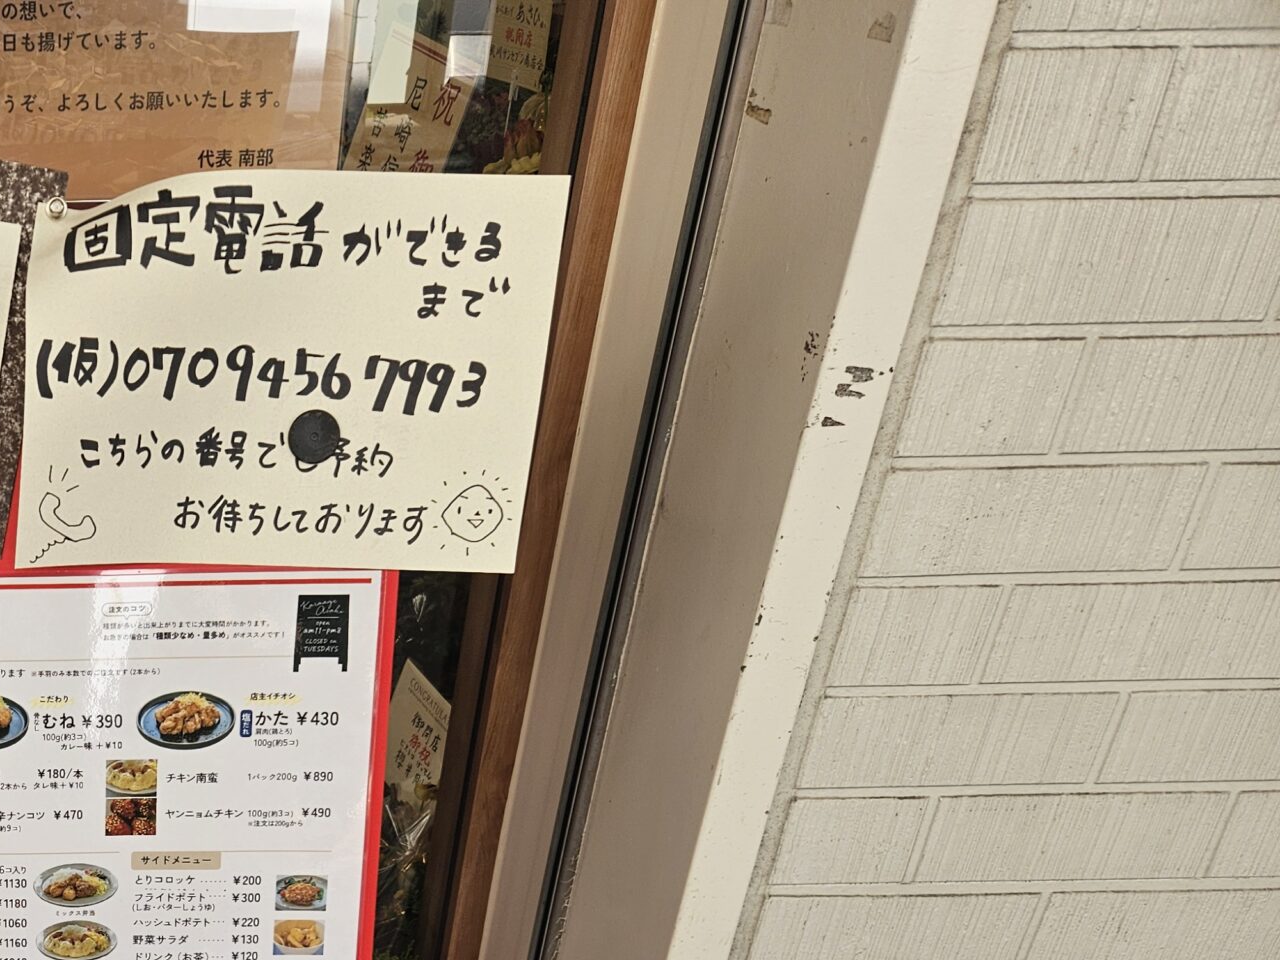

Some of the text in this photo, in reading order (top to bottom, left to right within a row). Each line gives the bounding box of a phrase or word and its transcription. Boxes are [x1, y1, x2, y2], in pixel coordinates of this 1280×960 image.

[197, 149, 274, 168] 代表 南部
[64, 185, 503, 274] 固定電話ができる
[417, 276, 511, 319] まで
[79, 426, 394, 479] こちらの番号で予約
[173, 494, 428, 545] お待ちしております
[39, 695, 70, 704] こだわり
[250, 692, 296, 701] 店主イチオシ
[42, 713, 76, 729] むね
[255, 710, 289, 726] かた
[165, 773, 219, 784] チキン南蛮
[303, 771, 334, 782] ¥890
[53, 809, 83, 820] ¥470
[165, 808, 244, 820] ヤンニョムチキン
[301, 807, 331, 818] ¥490
[141, 855, 212, 865] サイドメニュー
[134, 874, 262, 886] とりコロッケ ¥200
[231, 893, 261, 903] ¥300
[231, 917, 260, 928] ¥220
[133, 935, 259, 945] 野菜サラダ ¥130
